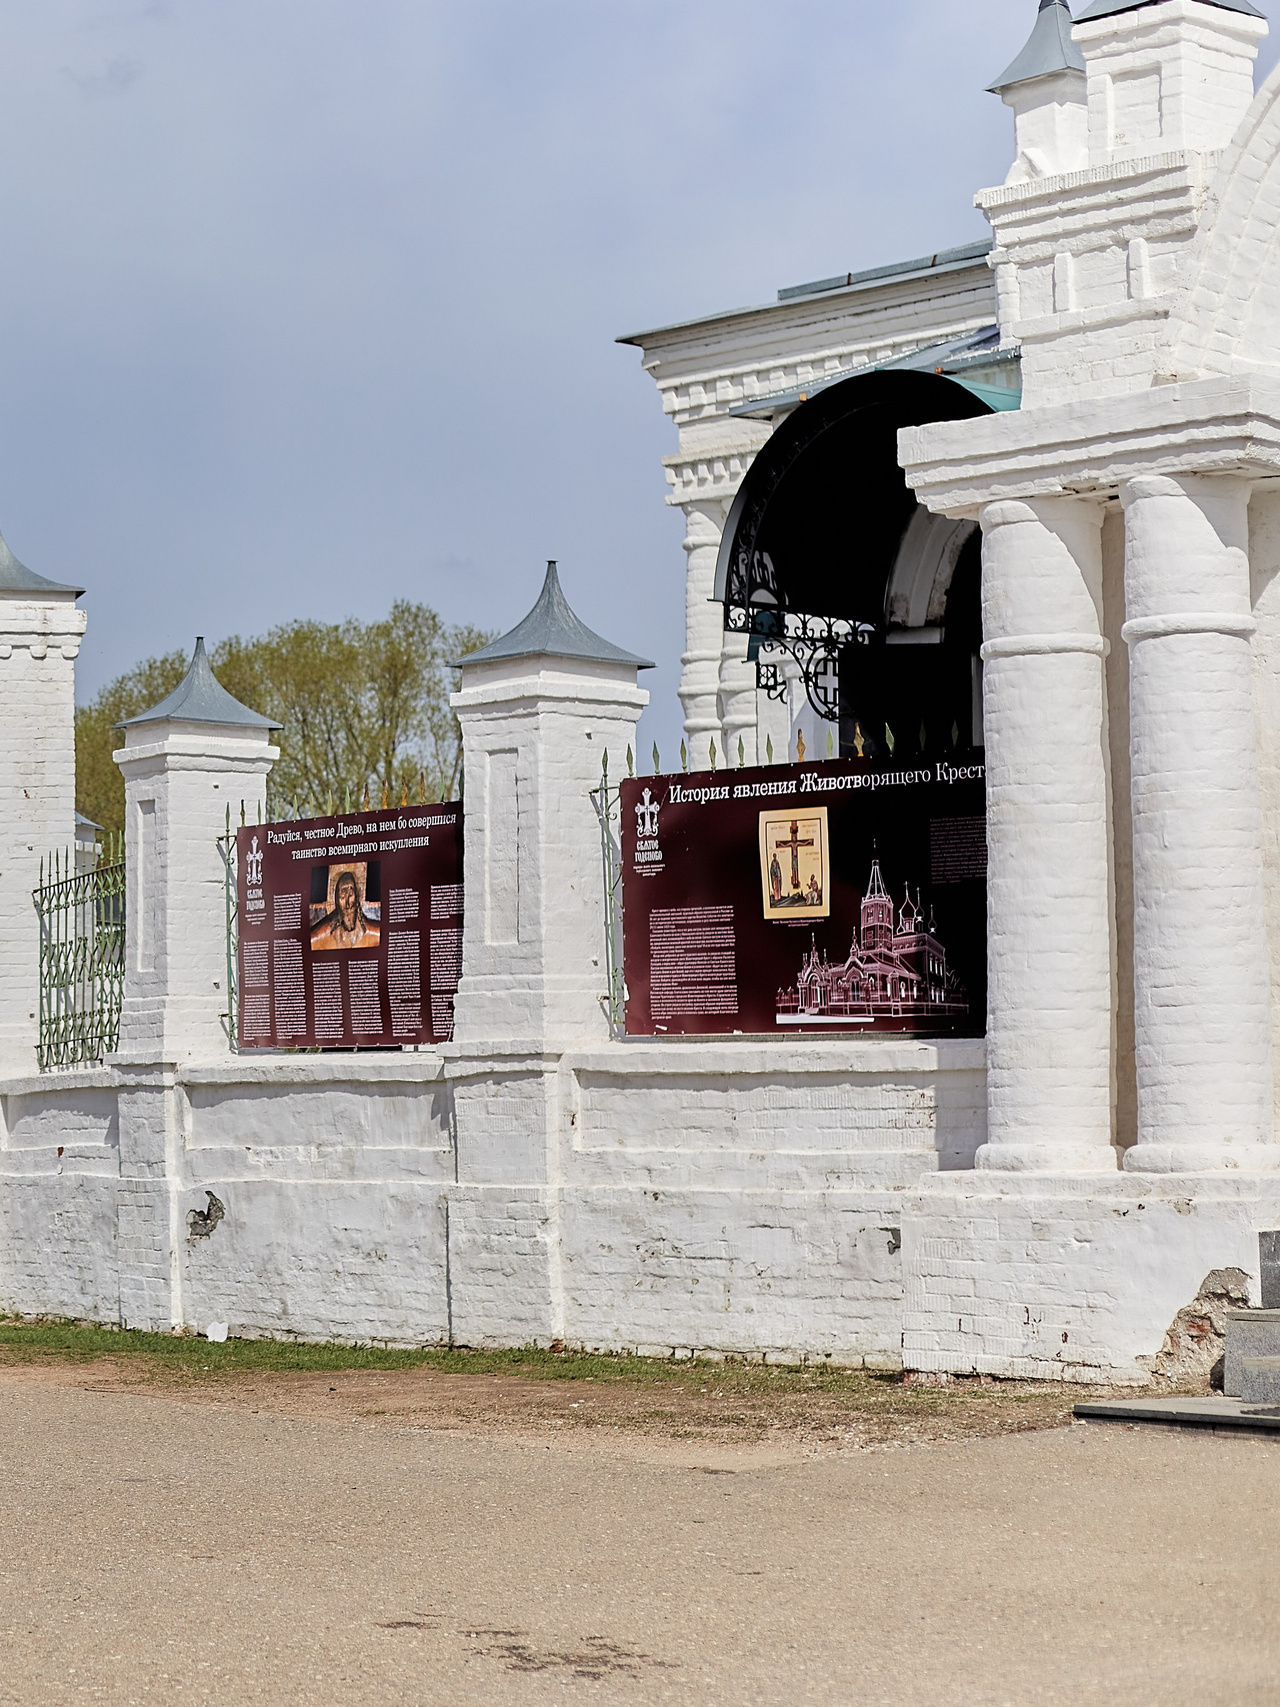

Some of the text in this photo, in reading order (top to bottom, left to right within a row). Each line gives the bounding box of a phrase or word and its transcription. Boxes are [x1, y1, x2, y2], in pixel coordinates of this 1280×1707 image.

[669, 761, 986, 804] История явления Животворящего Крест
[267, 813, 457, 845] Радуйся, честное Древо, на нем бо совершися
[291, 836, 430, 860] таинство всемирнаго искупления
